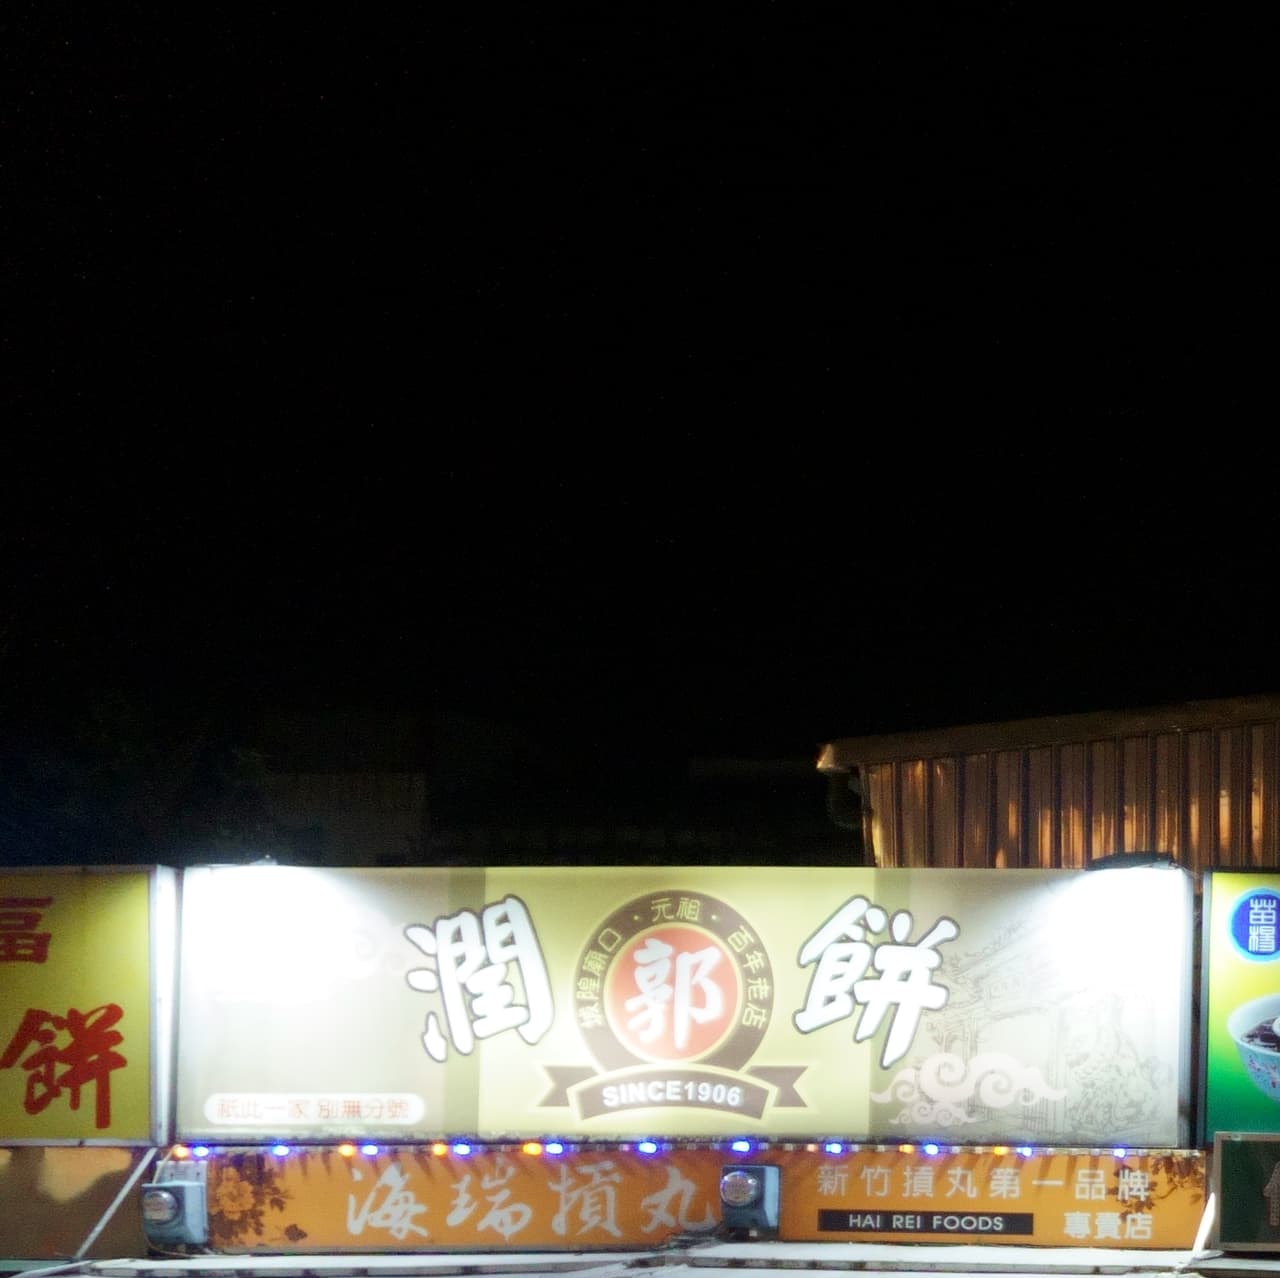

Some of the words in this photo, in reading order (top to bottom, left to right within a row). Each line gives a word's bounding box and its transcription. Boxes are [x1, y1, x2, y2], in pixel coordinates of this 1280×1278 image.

[650, 896, 702, 922] 元祖
[404, 893, 556, 1063] 潤
[624, 937, 724, 1050] 郭
[794, 895, 961, 1069] 餅
[848, 1213, 882, 1231] HAI
[891, 1214, 922, 1231] REI
[932, 1214, 1004, 1233] FOODS
[1063, 1210, 1153, 1240] 專賣店
